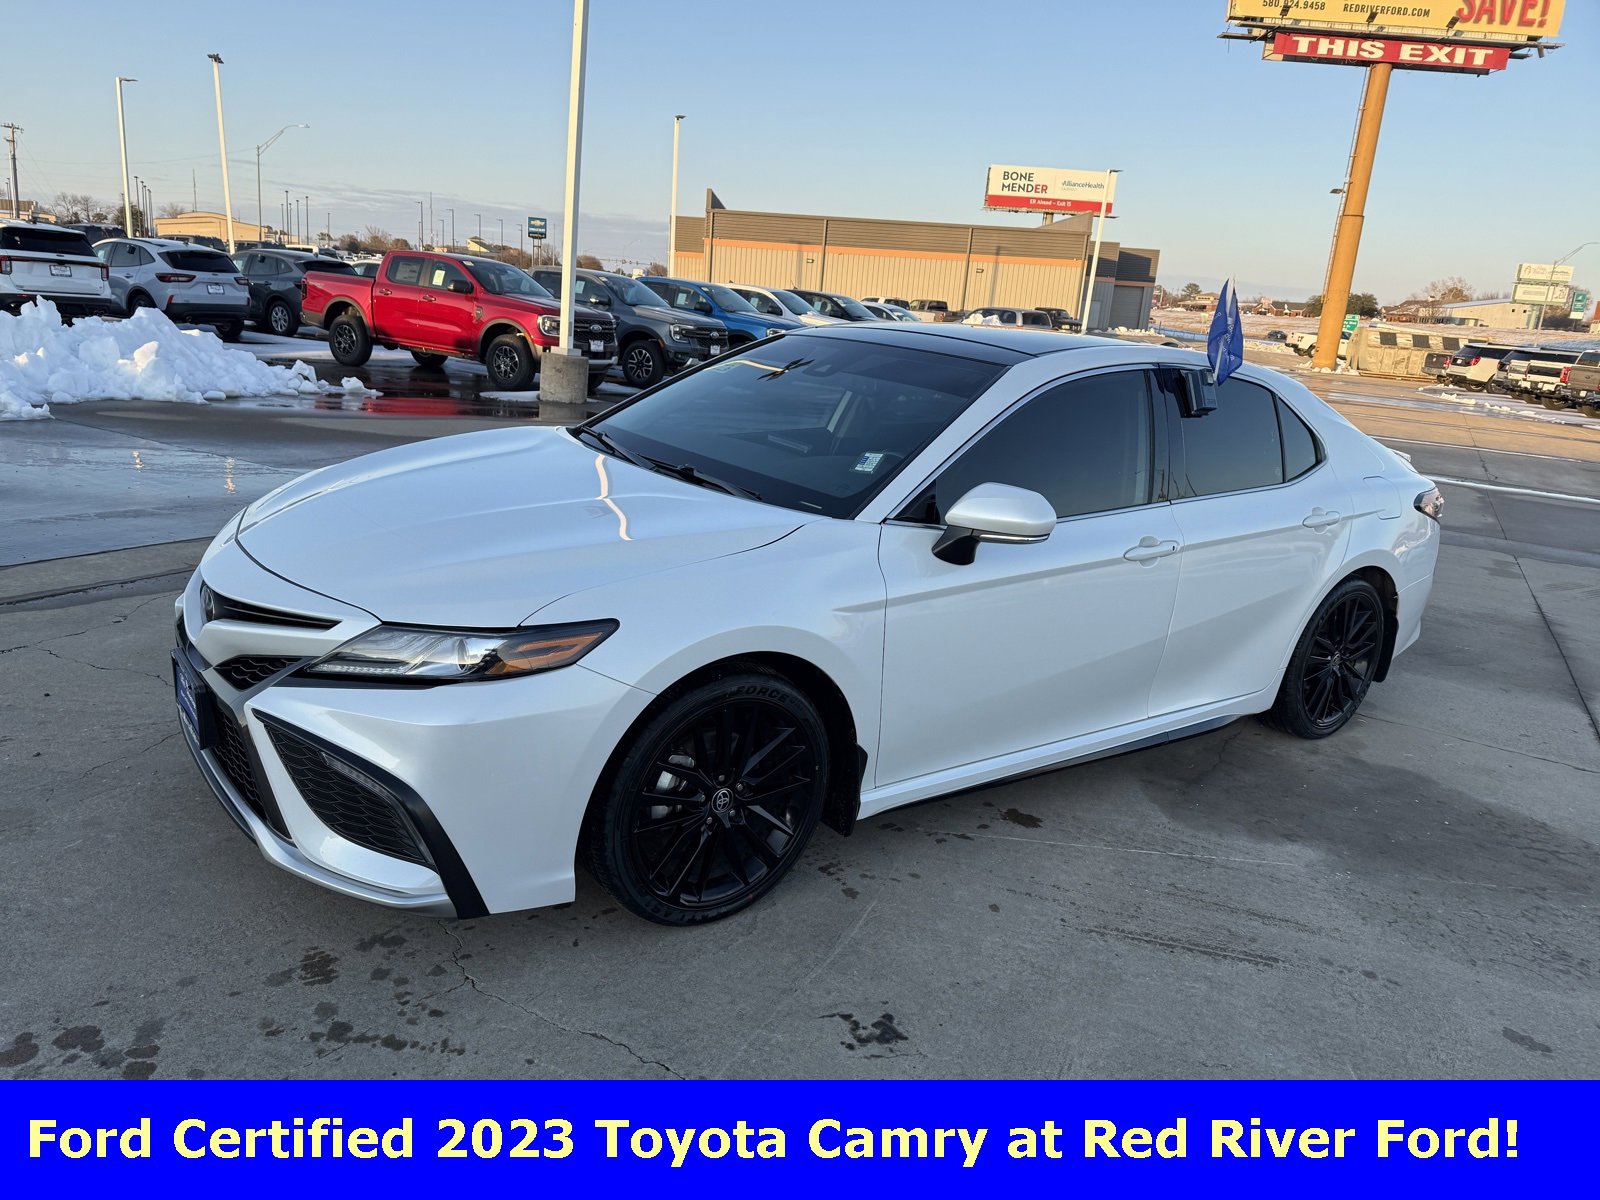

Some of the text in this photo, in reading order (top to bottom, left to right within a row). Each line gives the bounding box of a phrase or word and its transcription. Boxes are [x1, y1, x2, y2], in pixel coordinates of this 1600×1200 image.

[1343, 4, 1430, 18] REDRIVERFORD.COM
[1455, 0, 1552, 28] SAVE!
[1292, 36, 1494, 66] THIS EXIT
[1002, 171, 1034, 182] BONE
[1001, 183, 1048, 194] MENDER
[736, 685, 790, 704] FORCE
